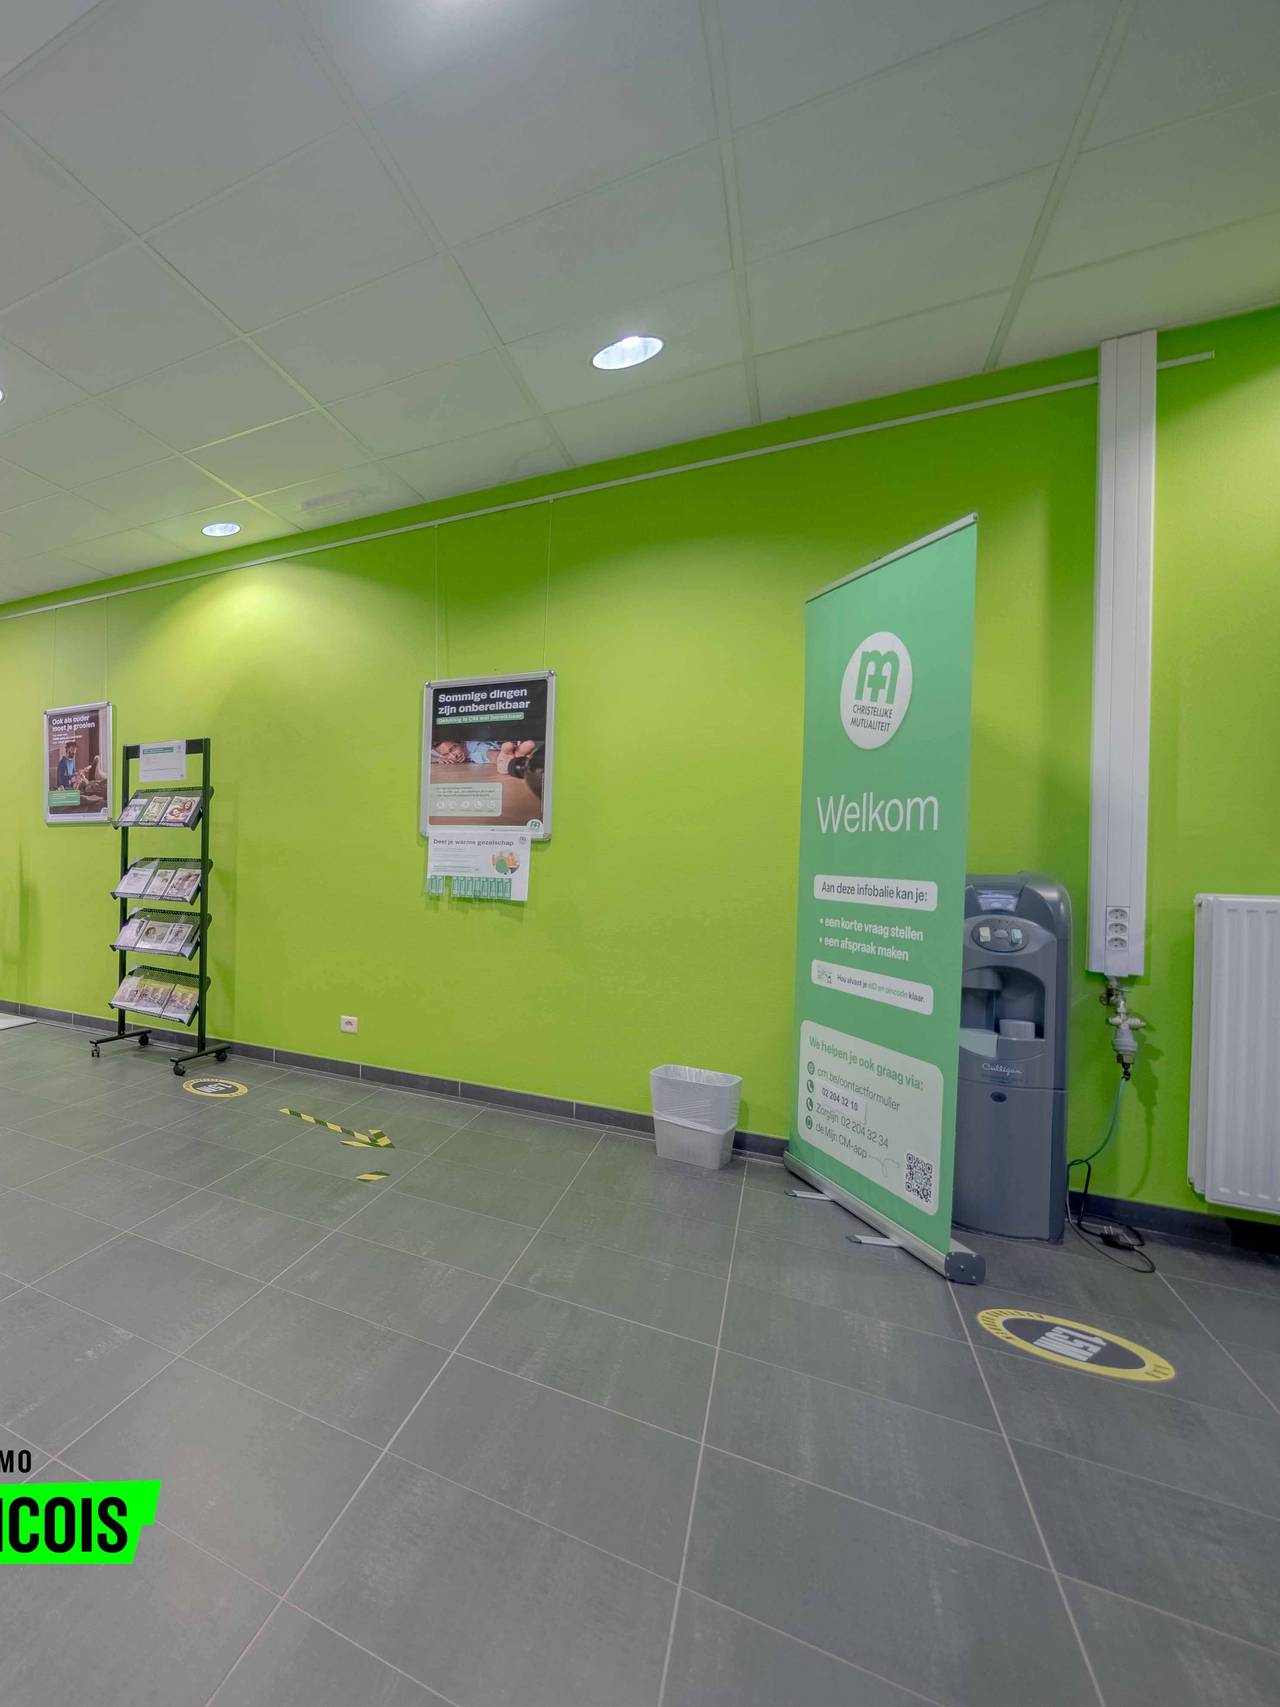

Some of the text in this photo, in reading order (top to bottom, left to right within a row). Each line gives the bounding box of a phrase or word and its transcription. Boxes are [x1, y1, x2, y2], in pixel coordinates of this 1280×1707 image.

[438, 688, 528, 702] Sommige dingen
[438, 700, 531, 716] zijn onbereikbaar
[852, 704, 894, 719] CHRISTELIJKE
[52, 714, 90, 726] Ook als ouder
[52, 721, 96, 733] moet je groeien
[850, 717, 892, 732] MUTUALITEIT
[817, 791, 939, 833] Welkom
[477, 839, 514, 847] gezelschap
[821, 881, 928, 903] Aan deze infobalie kan je:
[824, 917, 924, 941] een korte vraag stellen
[824, 937, 909, 961] een afspraak maken
[809, 1035, 924, 1091] We helpen je ook graag via:
[817, 1067, 901, 1112] cm.be/contactformulier
[821, 1087, 829, 1098] 02
[829, 1091, 840, 1103] 204
[840, 1115, 851, 1129] 02
[851, 1120, 866, 1137] 204
[866, 1128, 878, 1144] 32
[878, 1134, 889, 1149] 34
[838, 1133, 868, 1159] CM-app
